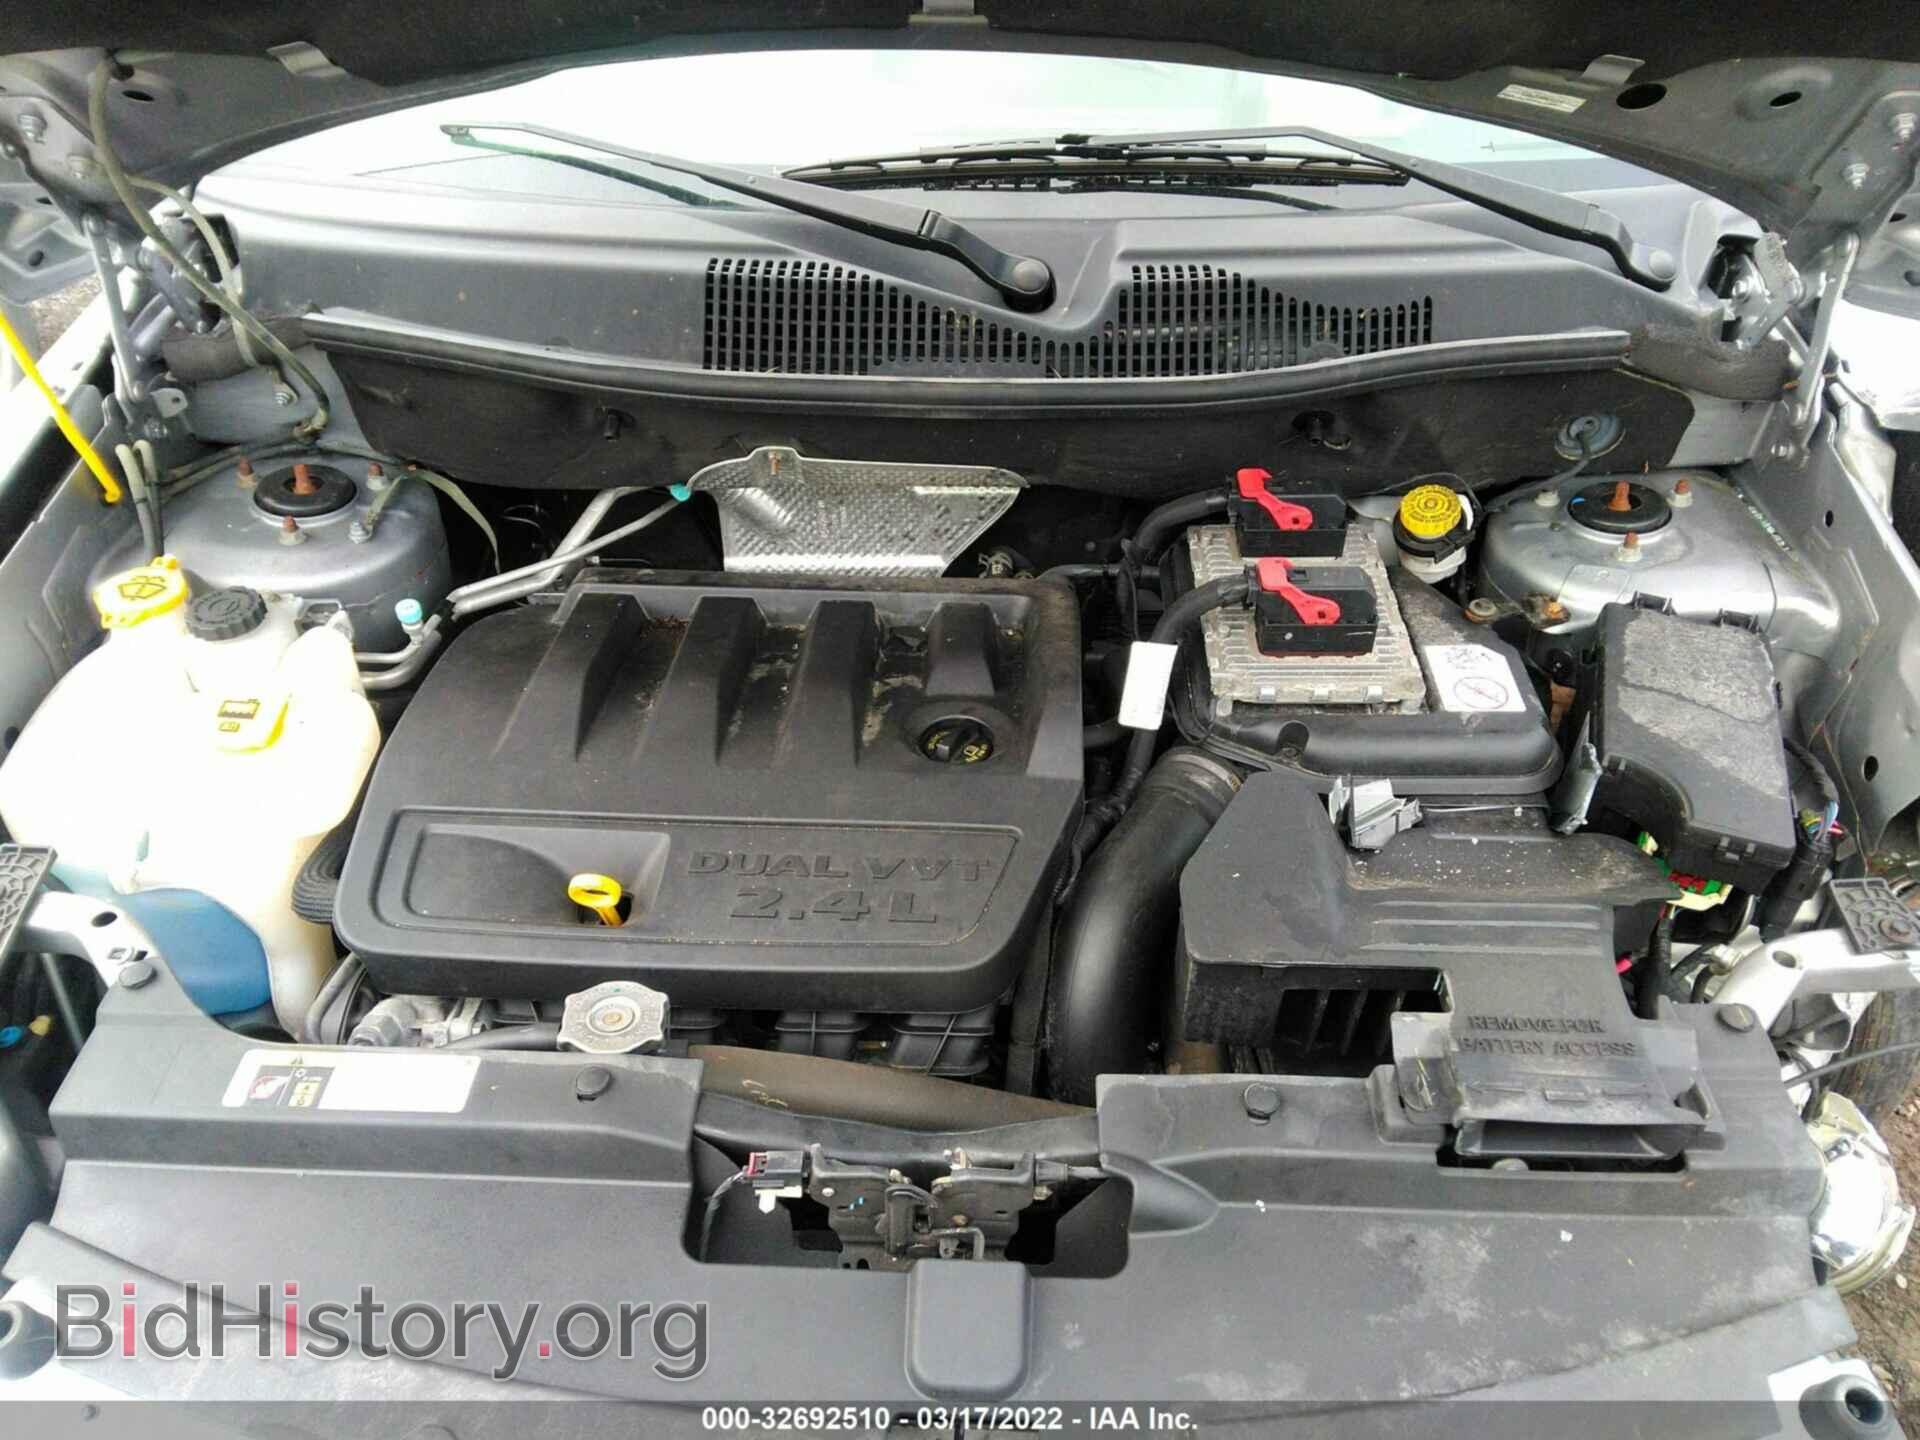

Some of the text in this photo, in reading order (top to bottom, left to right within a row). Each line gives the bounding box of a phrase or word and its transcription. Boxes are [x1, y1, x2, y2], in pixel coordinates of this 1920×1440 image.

[688, 854, 990, 881] DUAL VVT
[730, 887, 937, 923] 2.4L
[1469, 1016, 1604, 1033] REMOVE FOR
[1458, 1038, 1638, 1056] BATTERY ACCESS
